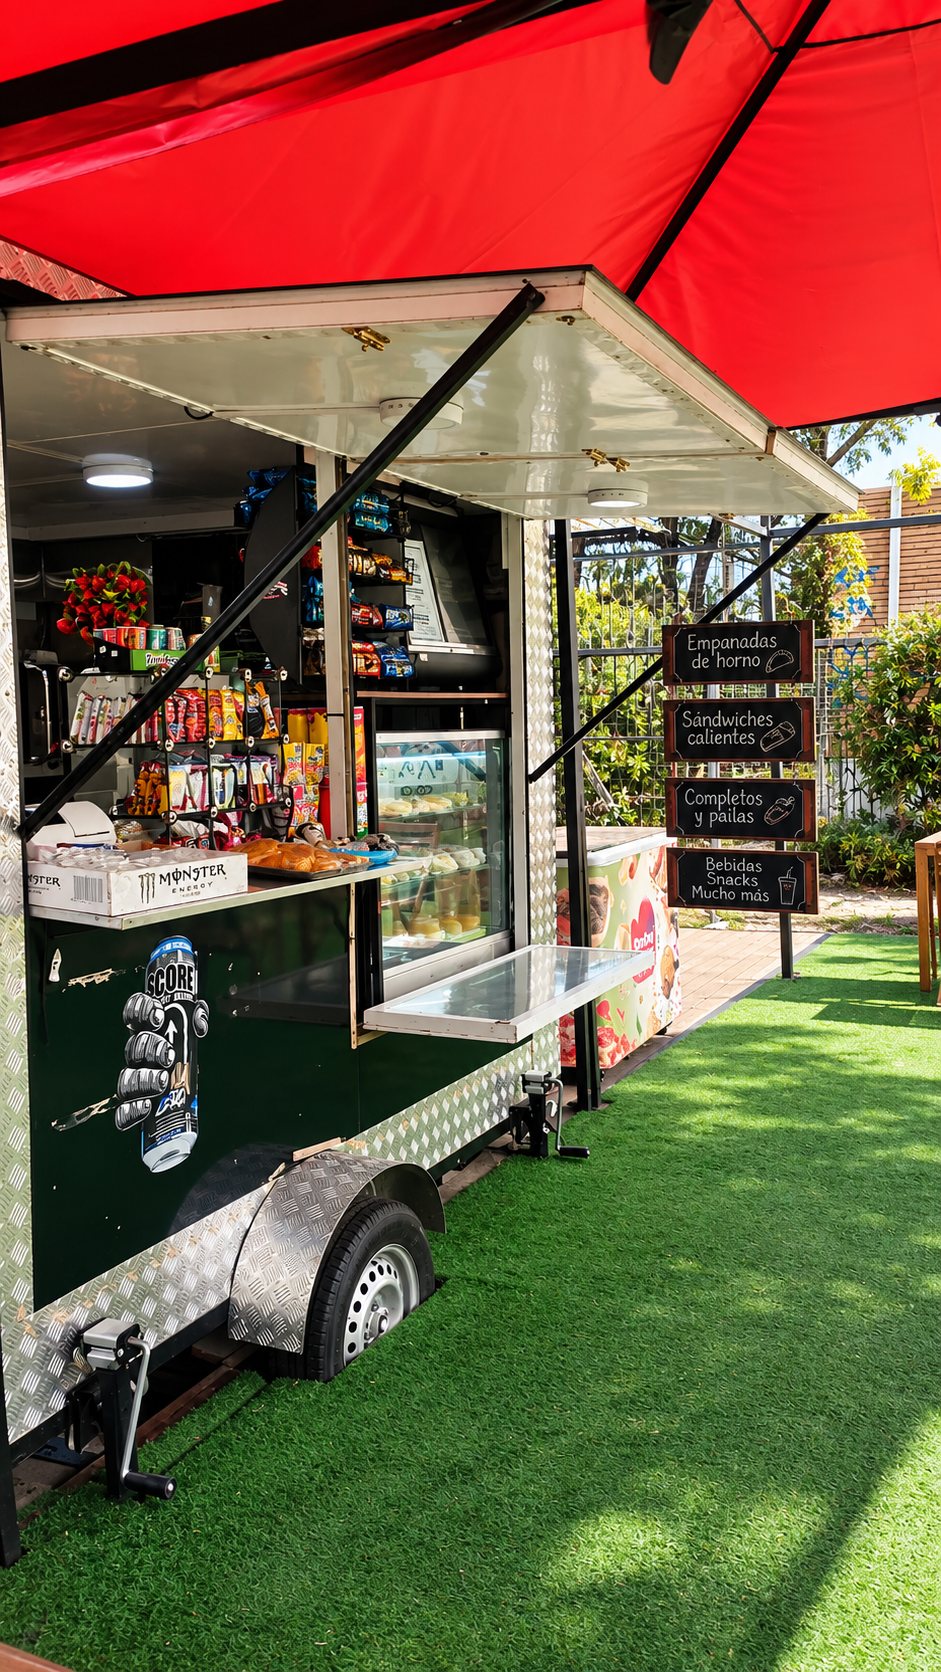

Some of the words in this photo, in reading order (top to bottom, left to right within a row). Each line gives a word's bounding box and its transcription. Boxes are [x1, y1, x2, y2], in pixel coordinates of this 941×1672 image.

[687, 631, 777, 657] Empanadas
[691, 651, 710, 669] de
[716, 652, 761, 669] horno
[682, 709, 774, 728] Sándwiches
[687, 727, 756, 746] calientes
[684, 788, 763, 814] Completos
[694, 811, 704, 828] y
[709, 806, 755, 829] pailas
[706, 856, 763, 873] Bebidas
[159, 863, 227, 886] MONSTER
[707, 871, 759, 888] Snacks
[691, 885, 737, 901] Mucho
[741, 887, 770, 903] más
[147, 962, 195, 998] SCORE
